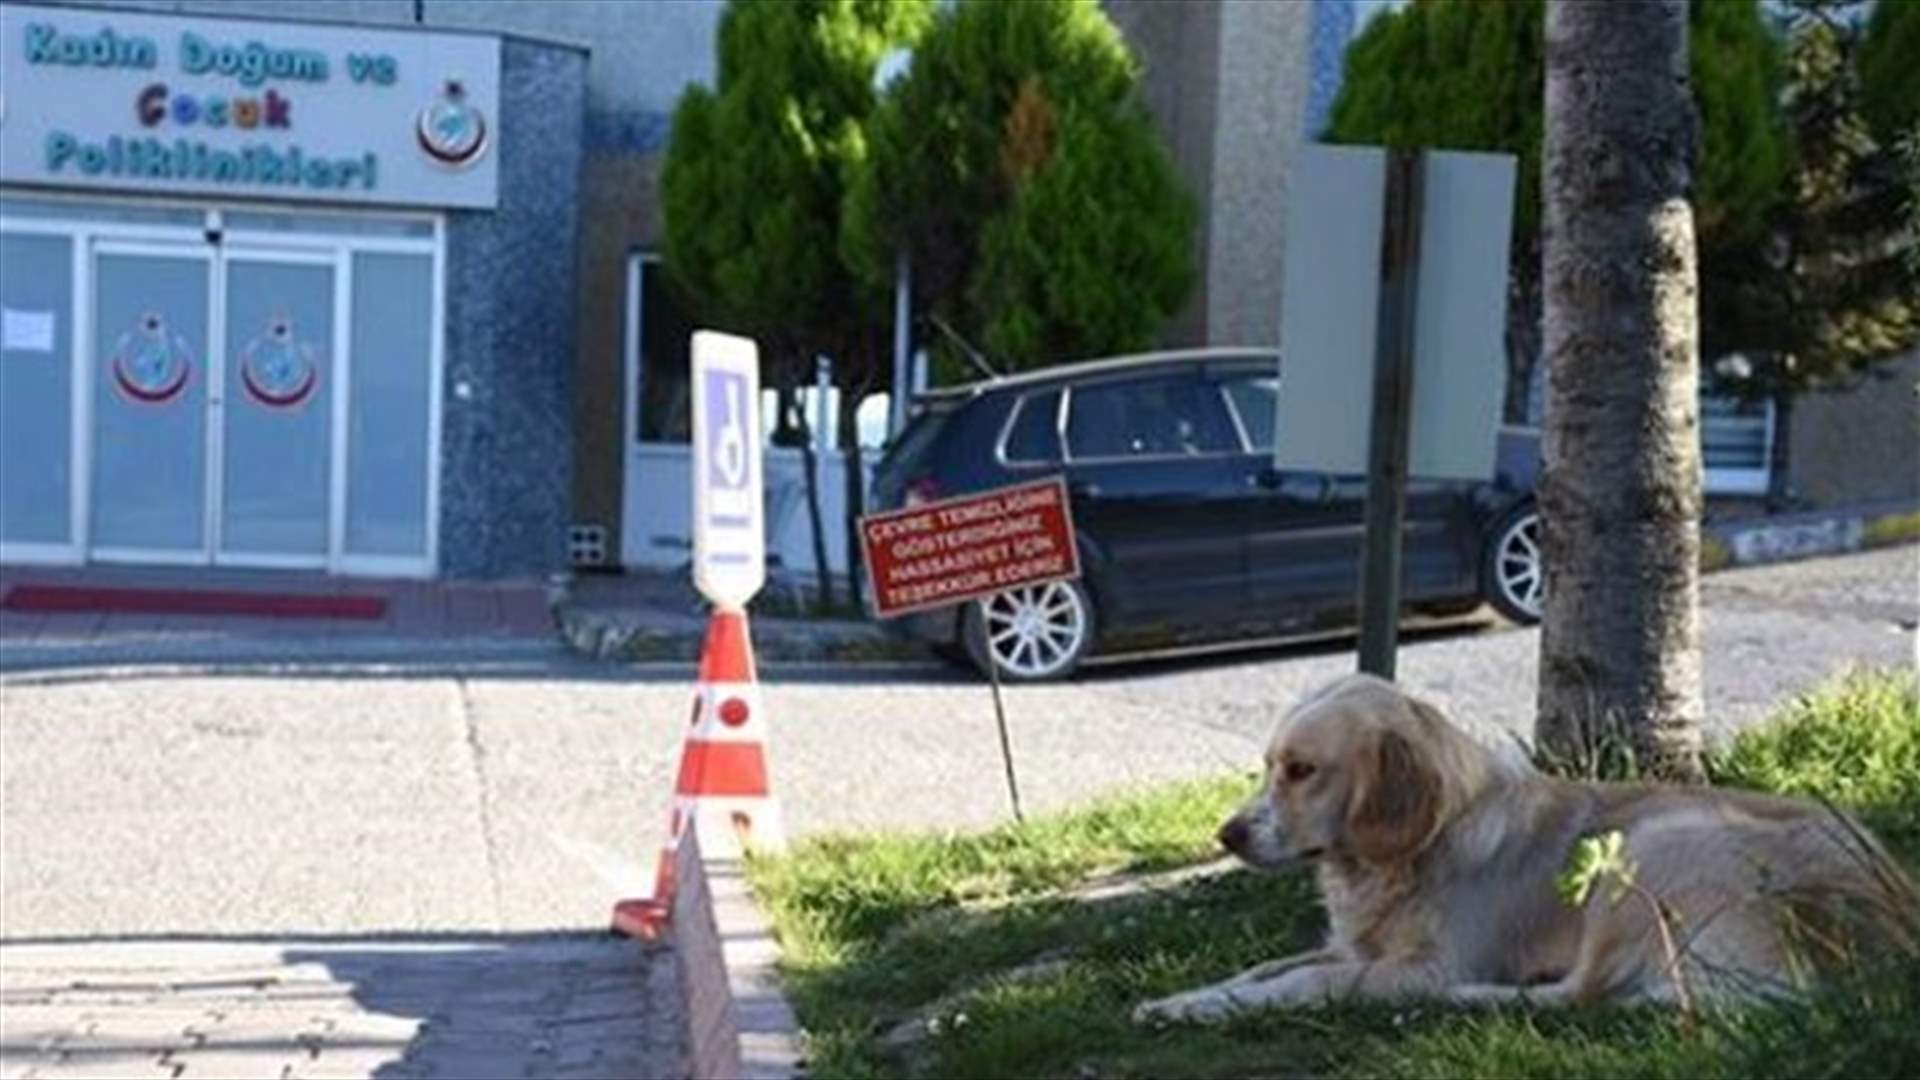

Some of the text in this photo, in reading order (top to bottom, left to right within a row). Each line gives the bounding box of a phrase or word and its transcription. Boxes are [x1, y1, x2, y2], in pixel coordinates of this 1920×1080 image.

[25, 23, 399, 87] Kadın Doğum ve
[45, 131, 377, 190] Poliklinikleri
